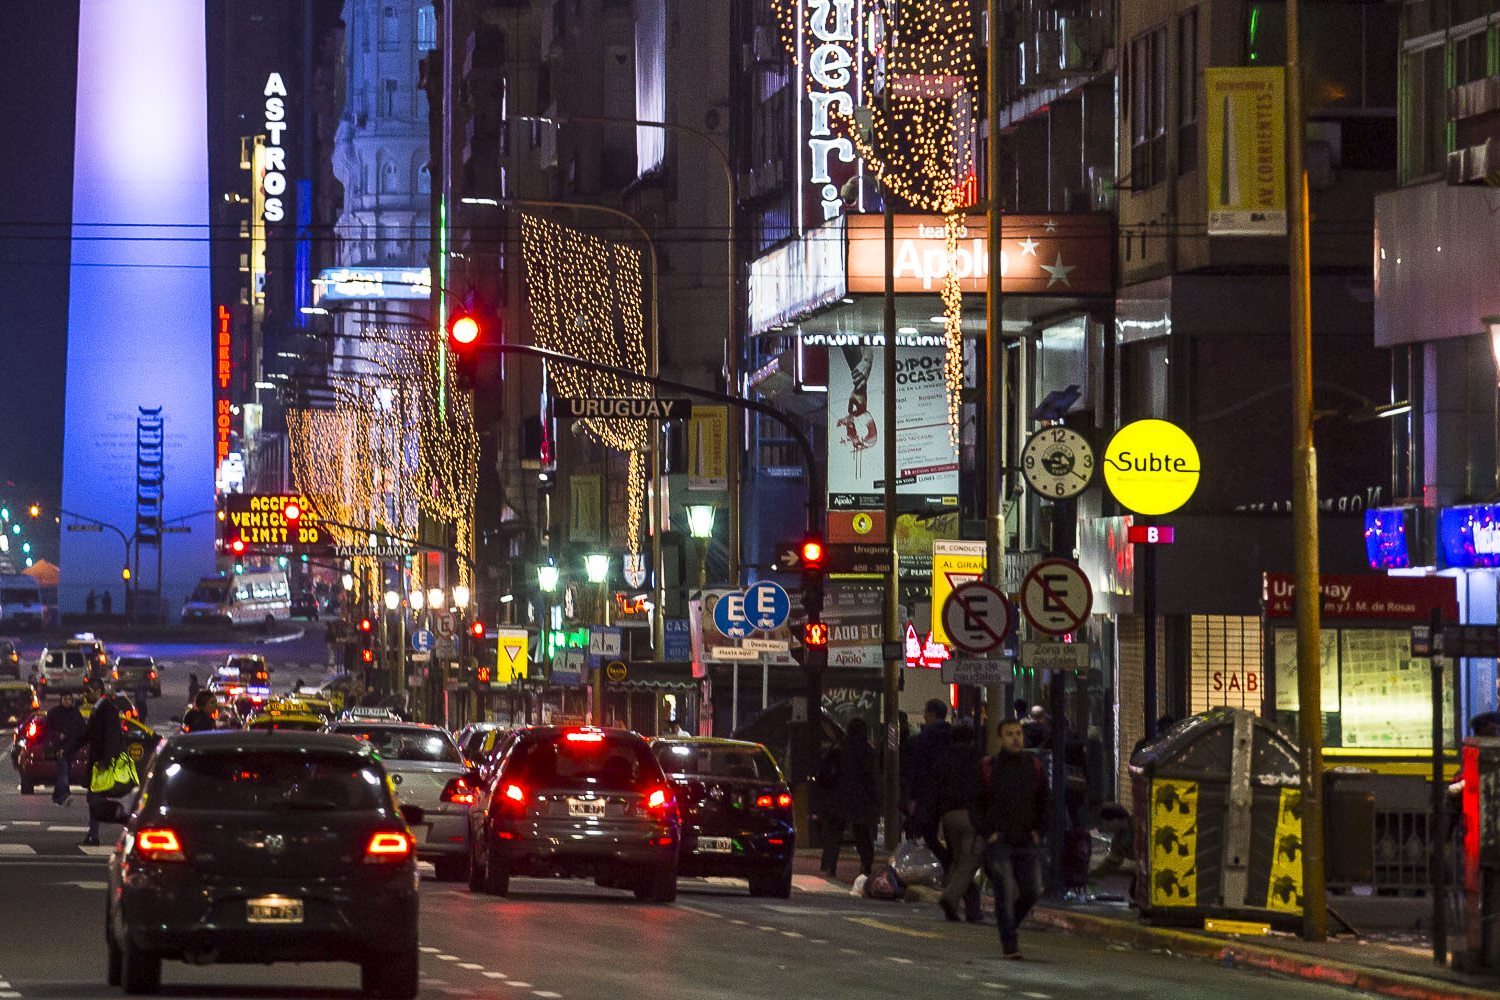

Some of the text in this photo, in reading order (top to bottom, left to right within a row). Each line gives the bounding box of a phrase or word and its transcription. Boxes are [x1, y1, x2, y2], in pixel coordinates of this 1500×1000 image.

[263, 72, 288, 222] ASTROS
[571, 399, 674, 417] URUGUAY
[1050, 429, 1066, 443] 12
[1025, 454, 1093, 469] 9 3
[1118, 451, 1187, 472] Subte
[1055, 482, 1065, 496] 6
[230, 511, 319, 527] VEHICUAR
[240, 527, 319, 543] LIMITDO
[1147, 526, 1158, 543] B
[333, 543, 411, 557] TALCAHUANO
[853, 545, 890, 555] Uruguay
[853, 563, 868, 572] 400
[875, 563, 890, 572] 300
[943, 561, 954, 569] AL
[757, 586, 776, 613] E
[1371, 601, 1386, 611] de
[1387, 601, 1416, 612] Rosas
[728, 595, 745, 621] E
[1036, 645, 1077, 655] Zona de
[957, 662, 998, 671] Zona de
